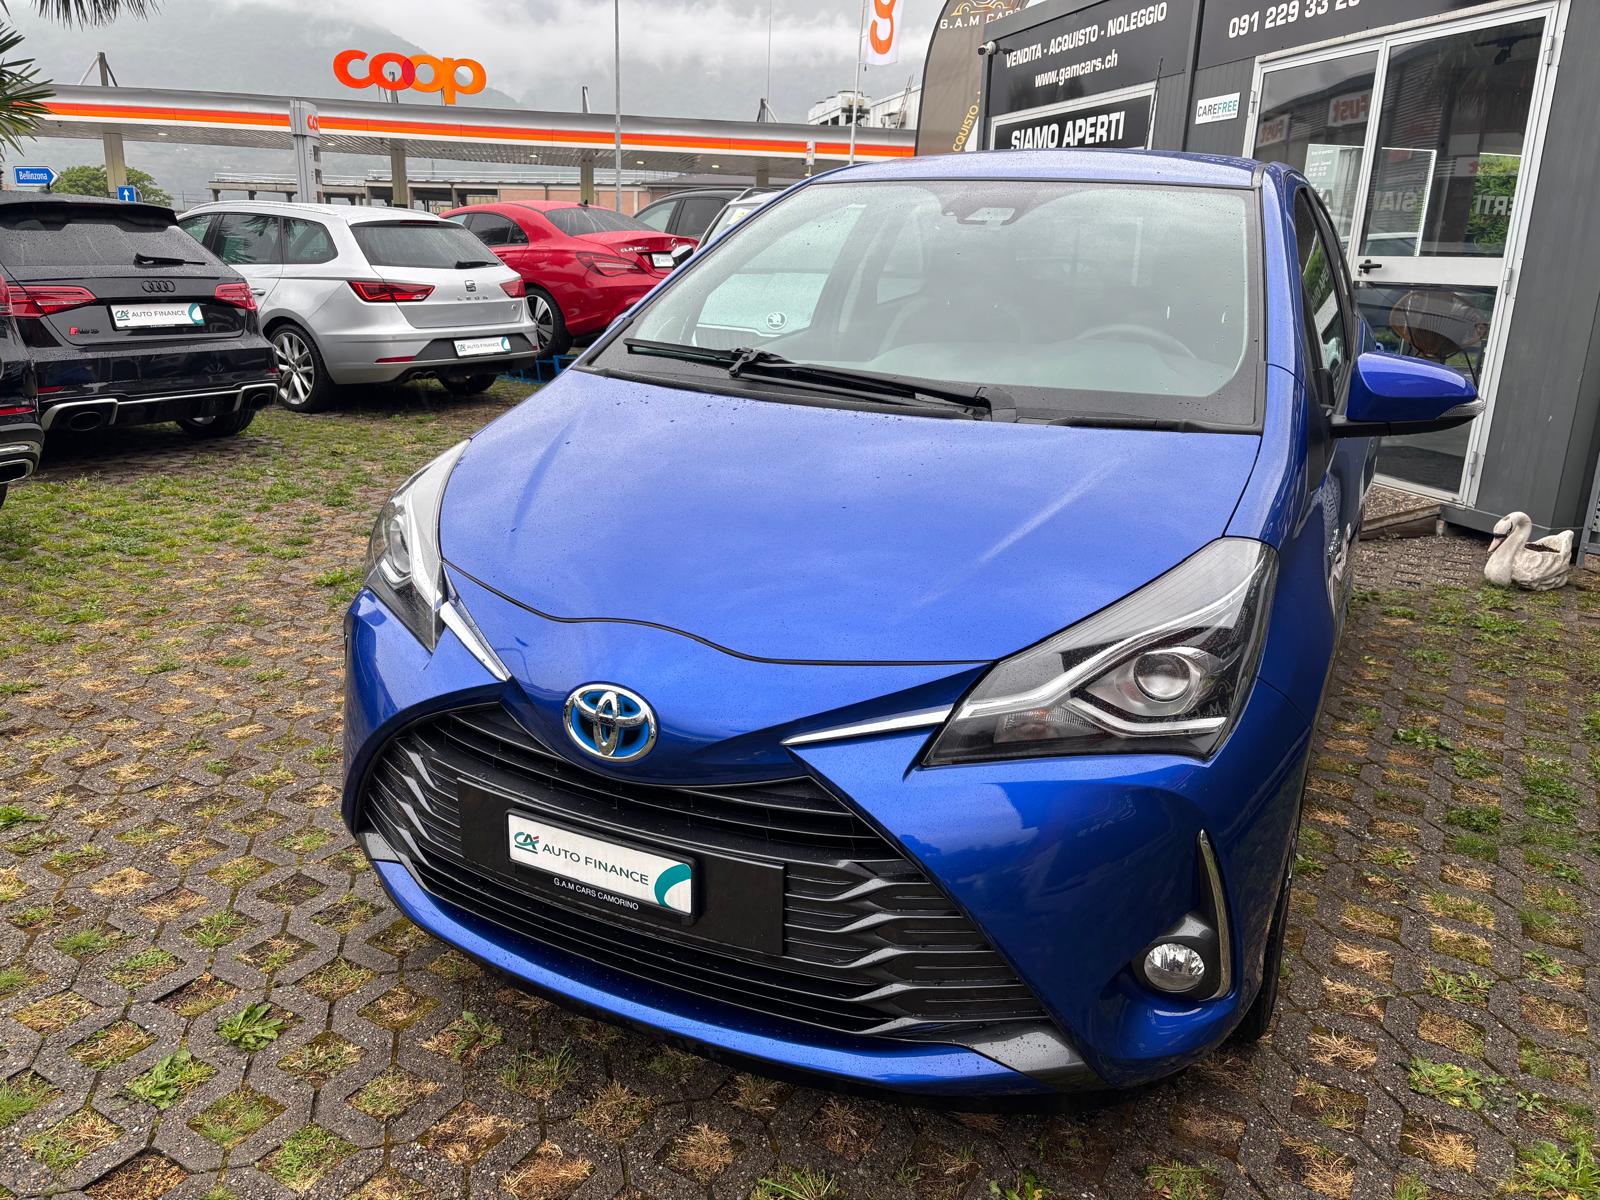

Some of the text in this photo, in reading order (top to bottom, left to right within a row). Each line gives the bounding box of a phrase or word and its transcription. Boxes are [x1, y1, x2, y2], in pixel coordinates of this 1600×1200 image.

[940, 15, 980, 30] G.A.M
[1006, 43, 1042, 68] VENDITA
[1048, 24, 1099, 56] ACQUISTO
[1107, 1, 1167, 38] NOLEGGIO
[1228, 11, 1260, 39] 091
[1264, 0, 1300, 29] 229
[333, 49, 487, 105] coop
[1034, 49, 1119, 88] www.gamcars.ch
[1197, 99, 1238, 117] CAREFREE
[952, 105, 979, 152] CQUISTO
[1011, 110, 1126, 149] SIAMO APERTI
[18, 170, 49, 181] Bellinzona
[154, 309, 187, 317] FINANCE
[542, 843, 581, 863] AUTO
[584, 856, 649, 886] FINANCE
[553, 877, 639, 911] G.A.M CARS CAMORINO
